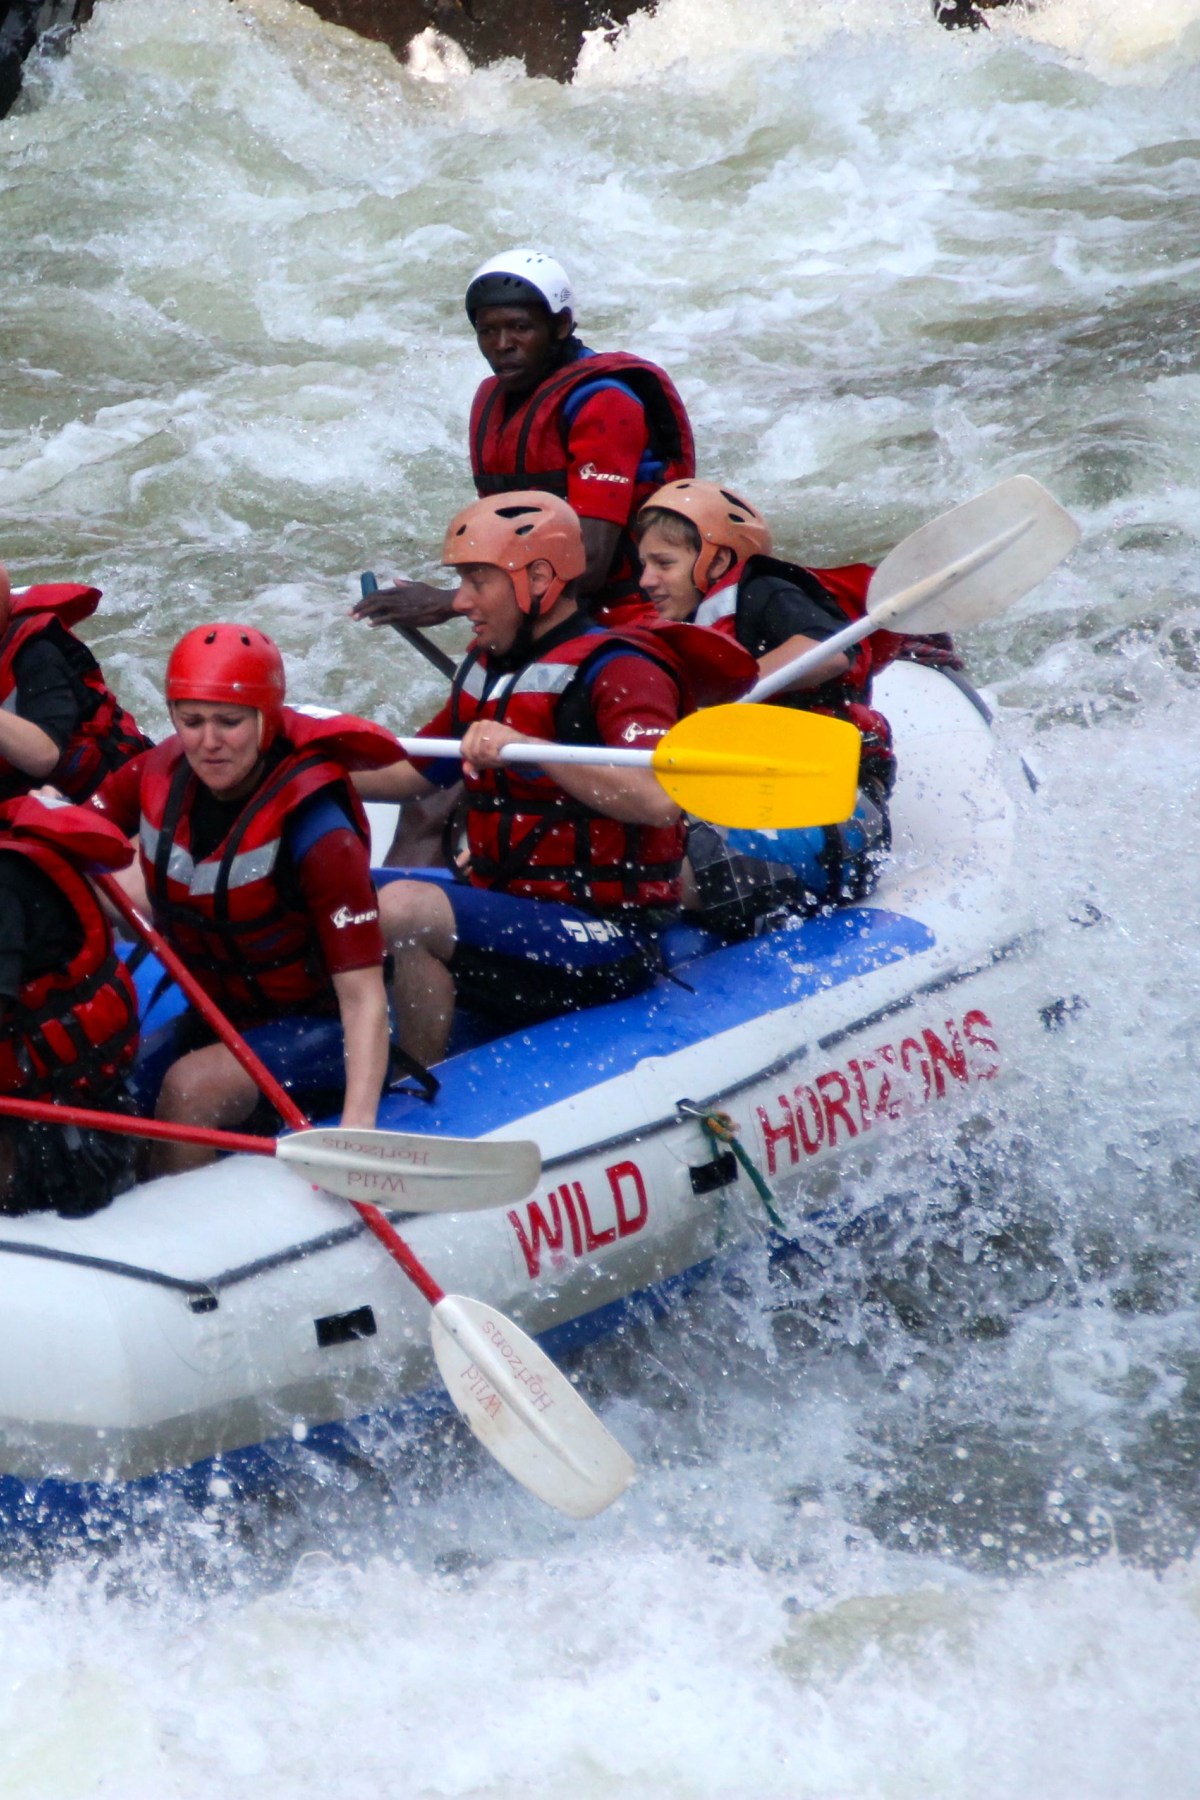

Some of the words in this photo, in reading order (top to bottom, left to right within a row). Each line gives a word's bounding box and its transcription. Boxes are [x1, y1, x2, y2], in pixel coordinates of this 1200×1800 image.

[322, 1138, 430, 1166] Horizons
[507, 1160, 648, 1280] WILD
[757, 1009, 1000, 1177] HORIZONS
[347, 1171, 406, 1193] Wild
[460, 1363, 503, 1421] Wild
[482, 1320, 555, 1413] Horizons
